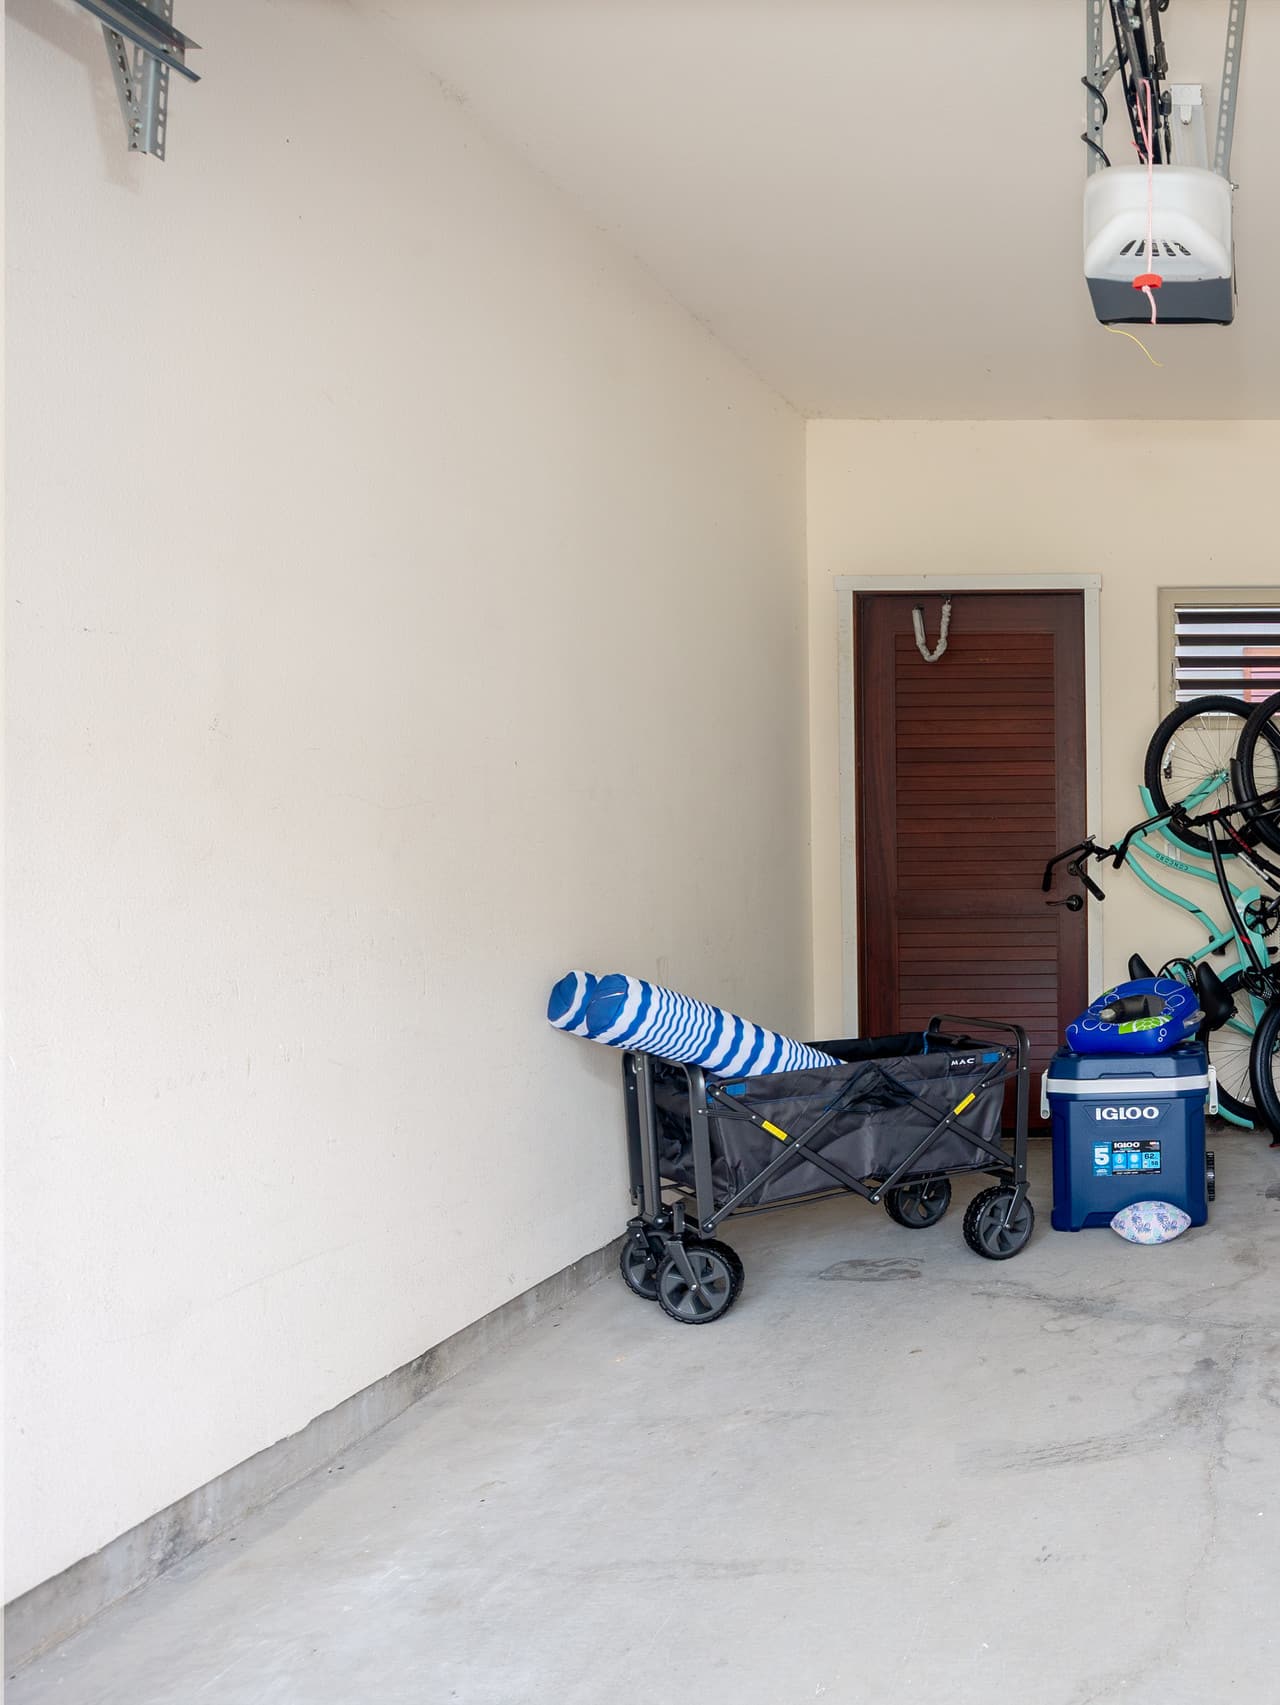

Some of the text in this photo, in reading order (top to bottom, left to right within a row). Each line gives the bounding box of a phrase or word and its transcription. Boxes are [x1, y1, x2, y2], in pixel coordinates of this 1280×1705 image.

[951, 1057, 976, 1067] MAC
[1095, 1106, 1160, 1121] IGLOO
[1113, 1141, 1141, 1149] IGLOO
[1094, 1147, 1110, 1166] 5
